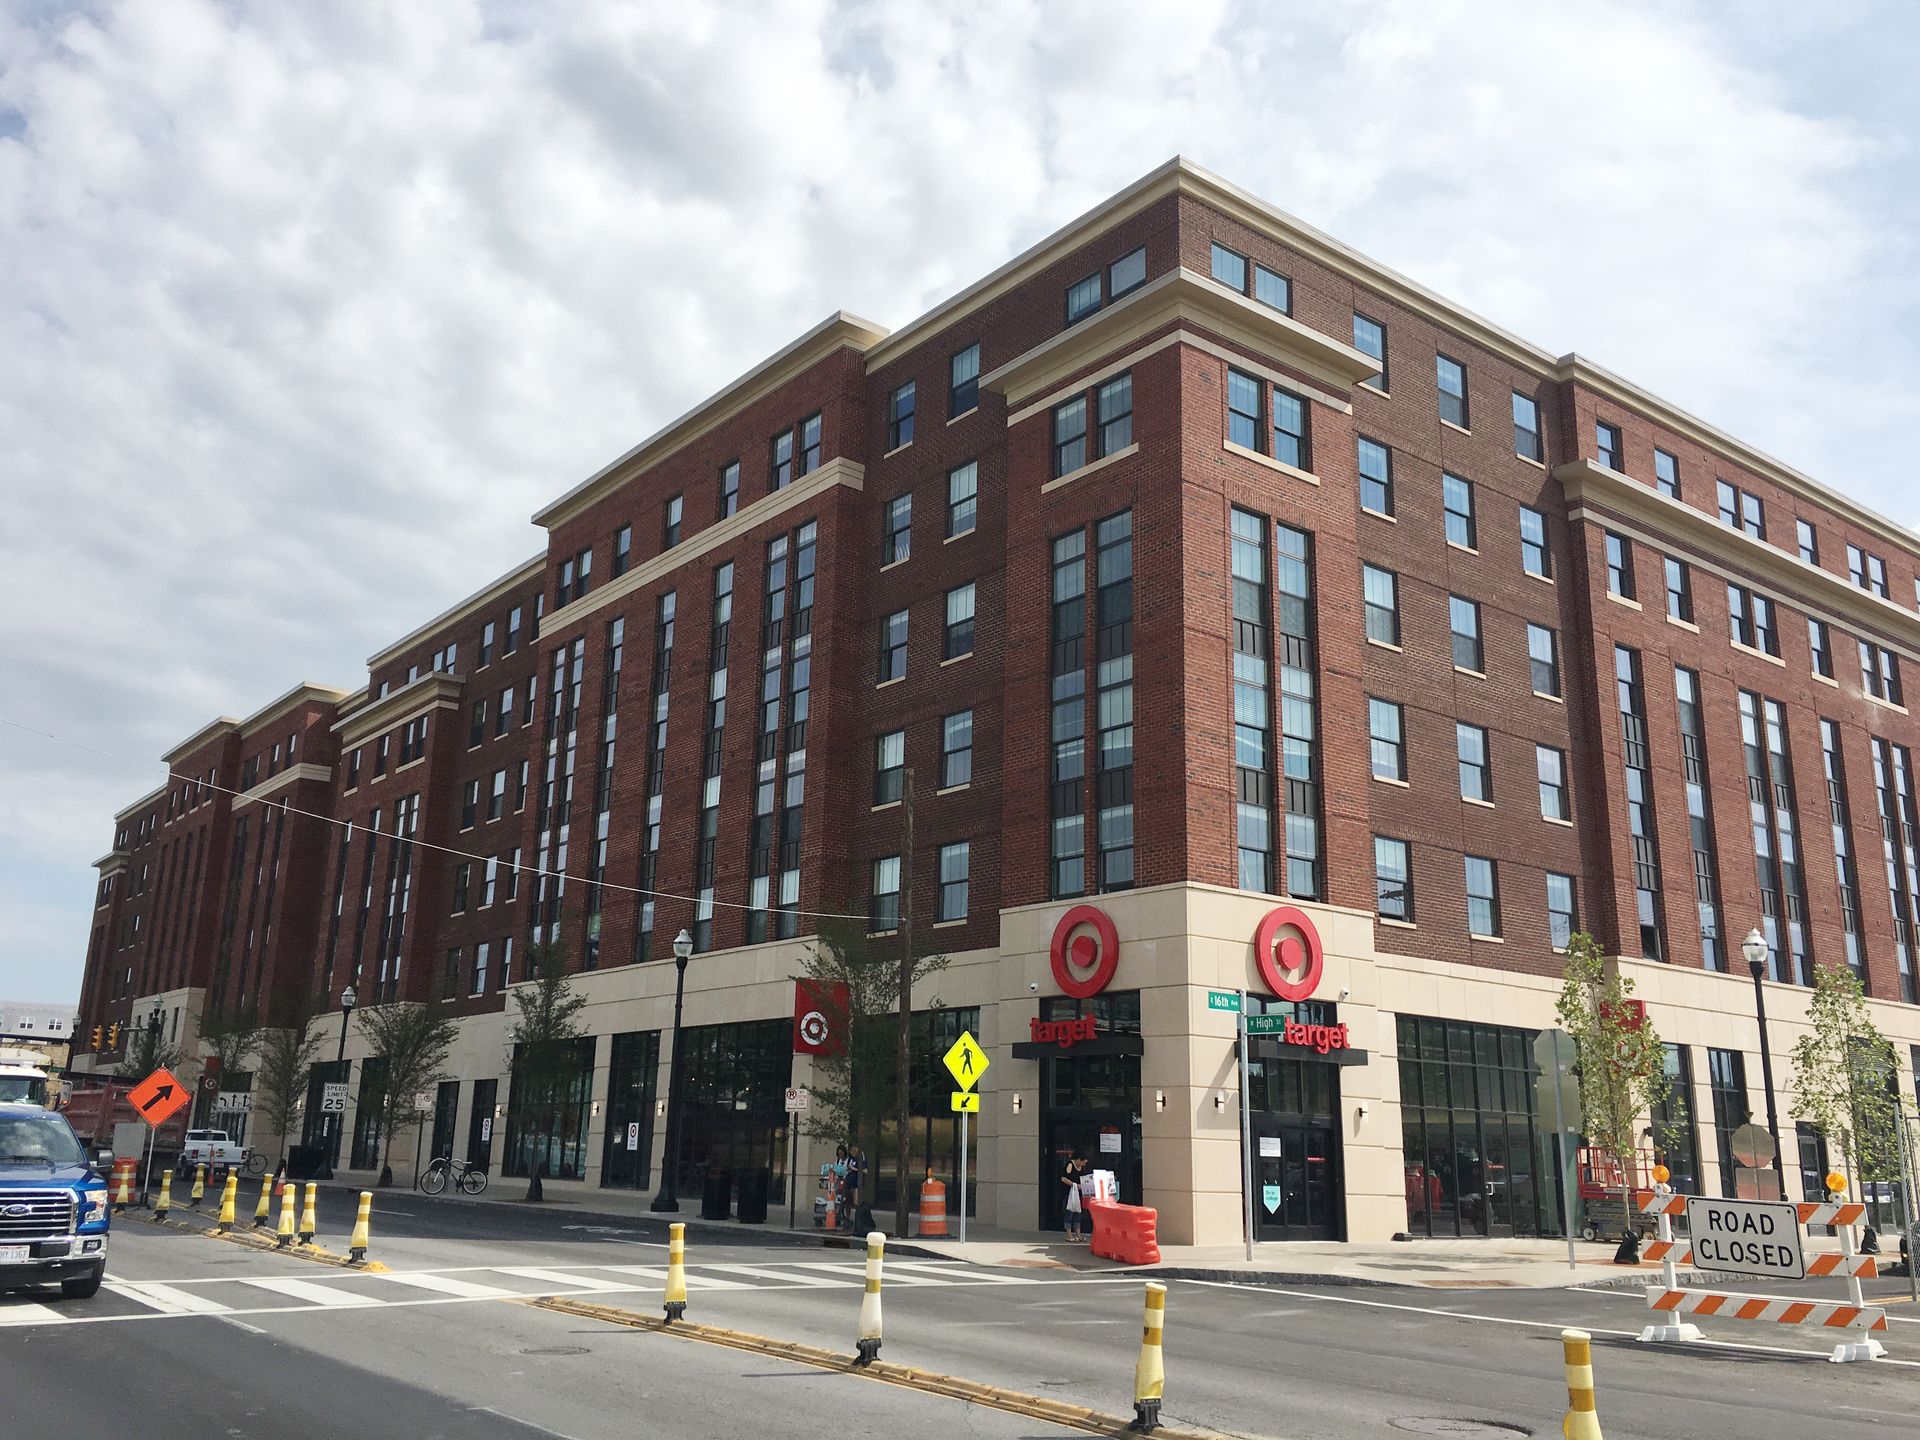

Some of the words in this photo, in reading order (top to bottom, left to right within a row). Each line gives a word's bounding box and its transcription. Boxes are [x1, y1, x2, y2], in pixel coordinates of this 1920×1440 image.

[1214, 995, 1229, 1007] 16th
[1030, 1012, 1098, 1048] target
[1256, 1017, 1274, 1031] High
[1285, 1016, 1350, 1054] target
[324, 1099, 344, 1110] 25
[1708, 1209, 1775, 1236] ROAD
[1700, 1238, 1794, 1268] CLOSED
